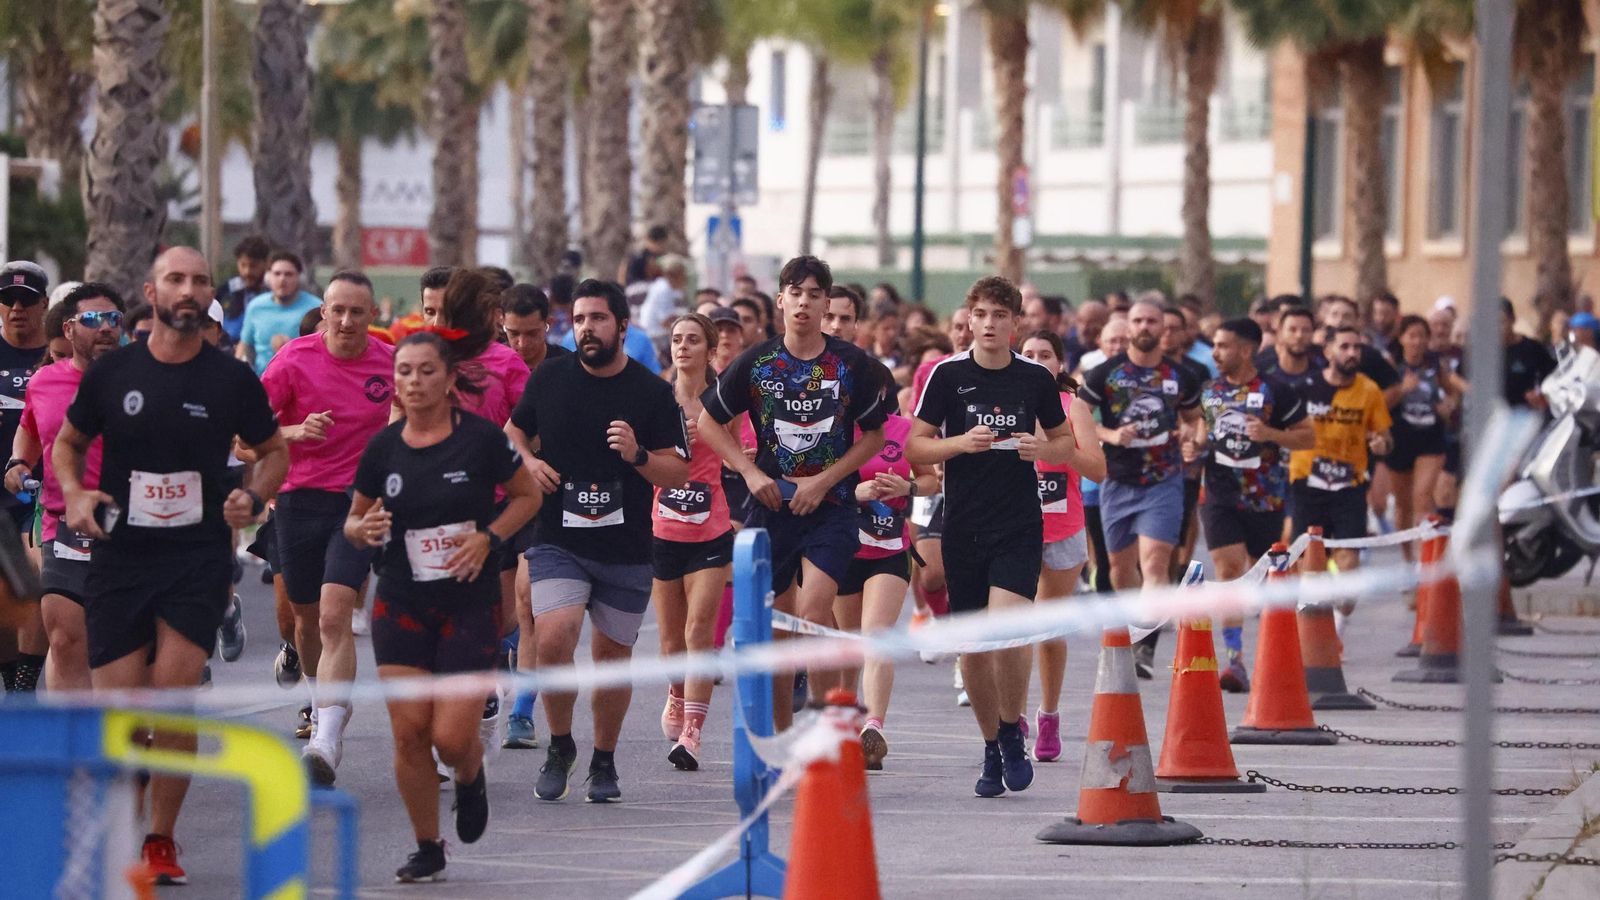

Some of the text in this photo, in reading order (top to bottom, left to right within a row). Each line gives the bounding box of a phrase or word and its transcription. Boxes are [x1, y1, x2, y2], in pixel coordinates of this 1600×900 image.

[784, 398, 823, 411] 1087
[976, 413, 1017, 427] 1088
[1226, 438, 1251, 451] 867
[144, 484, 186, 499] 3153
[1038, 480, 1058, 492] 30
[577, 491, 611, 504] 858
[668, 488, 705, 503] 2976
[871, 515, 895, 528] 182
